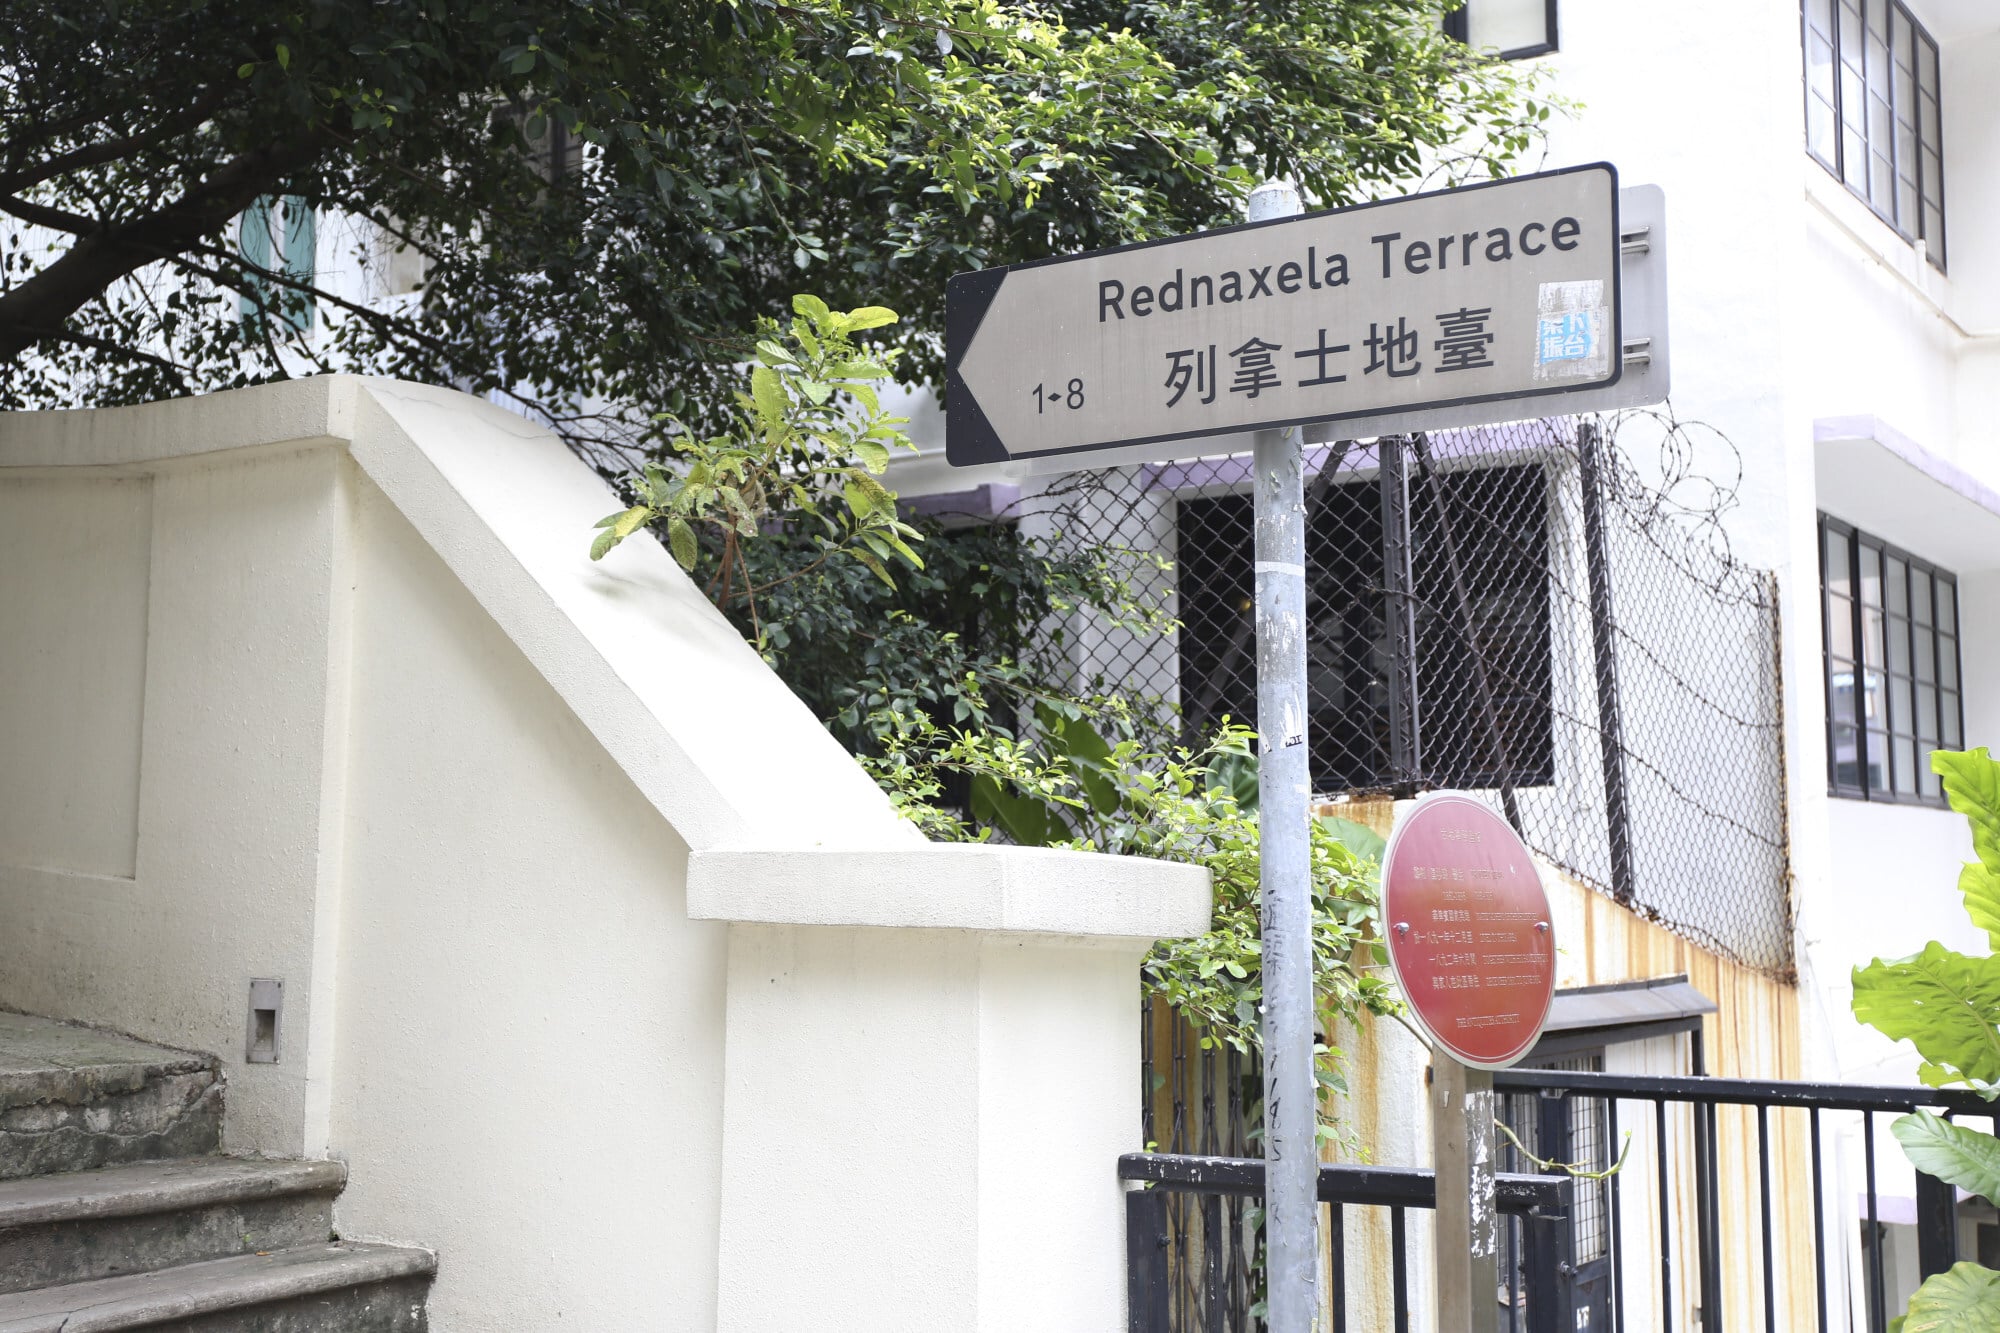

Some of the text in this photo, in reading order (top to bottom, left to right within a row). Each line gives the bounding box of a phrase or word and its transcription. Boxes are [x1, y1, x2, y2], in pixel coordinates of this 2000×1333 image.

[1099, 216, 1581, 323] Rednaxela Terrace
[1164, 307, 1494, 409] 列拿士地臺
